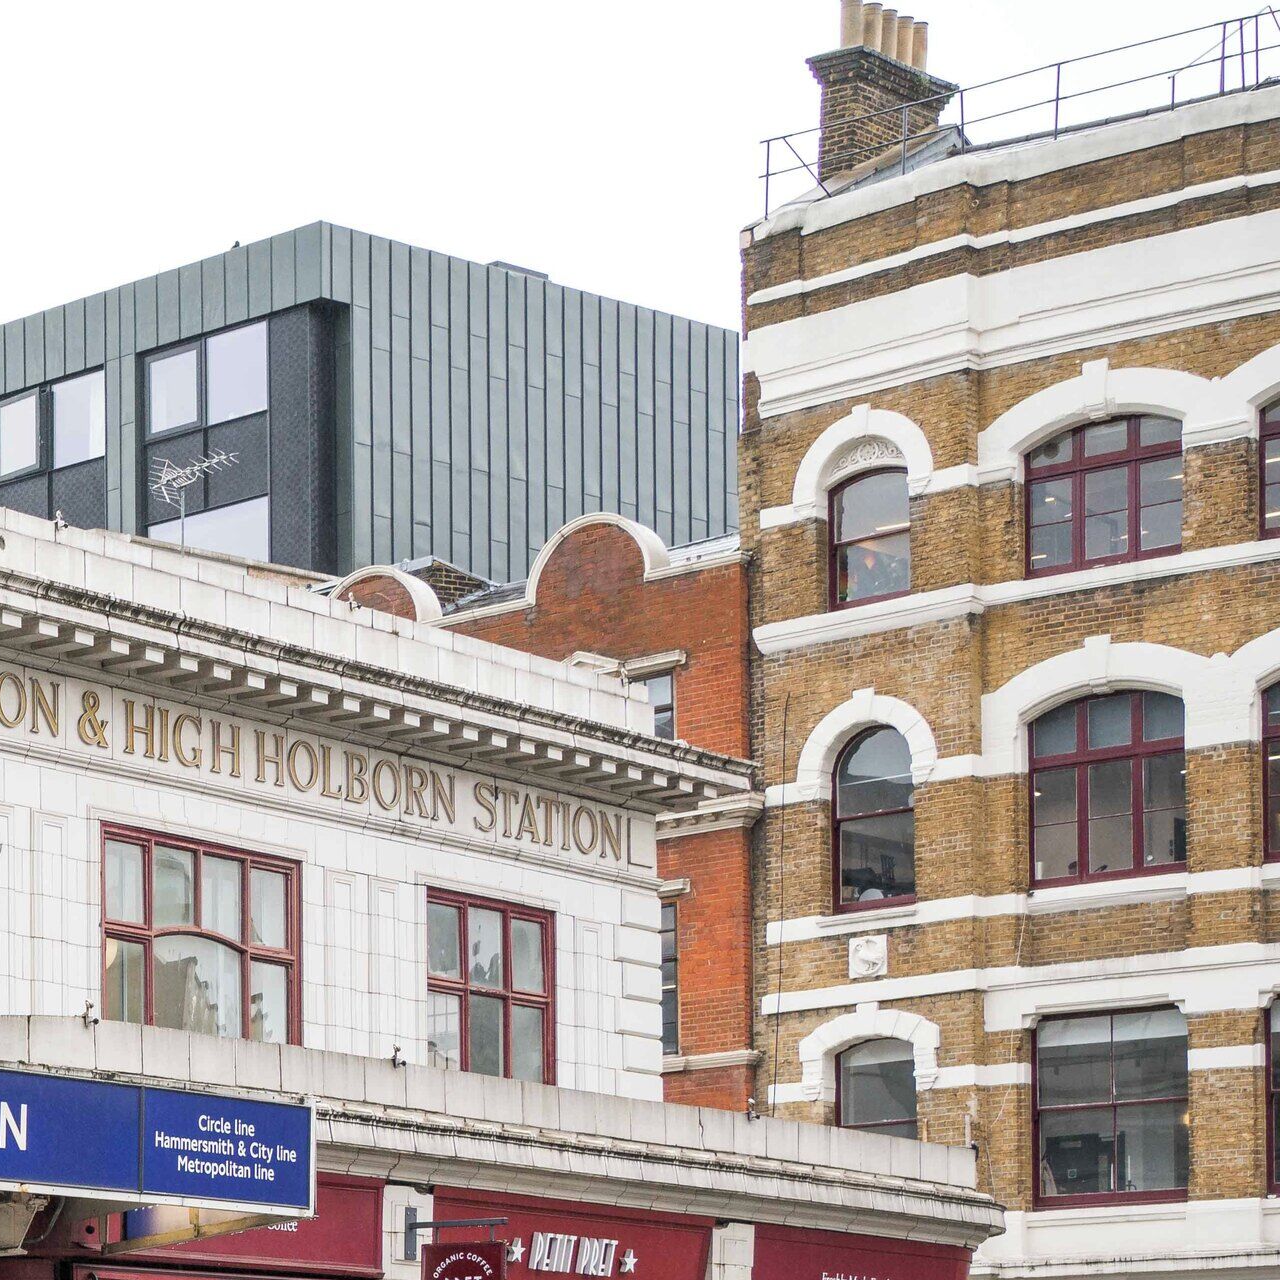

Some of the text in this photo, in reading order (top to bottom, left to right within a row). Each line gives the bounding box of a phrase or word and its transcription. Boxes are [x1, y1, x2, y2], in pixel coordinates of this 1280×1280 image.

[77, 690, 109, 748] &
[124, 701, 241, 777] HIGH
[254, 728, 456, 825] HOLBORN
[473, 782, 622, 862] STATION
[198, 1115, 254, 1136] Circle line
[155, 1131, 296, 1162] Hammersmith & City line
[177, 1155, 274, 1180] Metropolitan line
[433, 1252, 492, 1279] ORGANIC COFFEE
[529, 1231, 618, 1277] PETIT PRET
